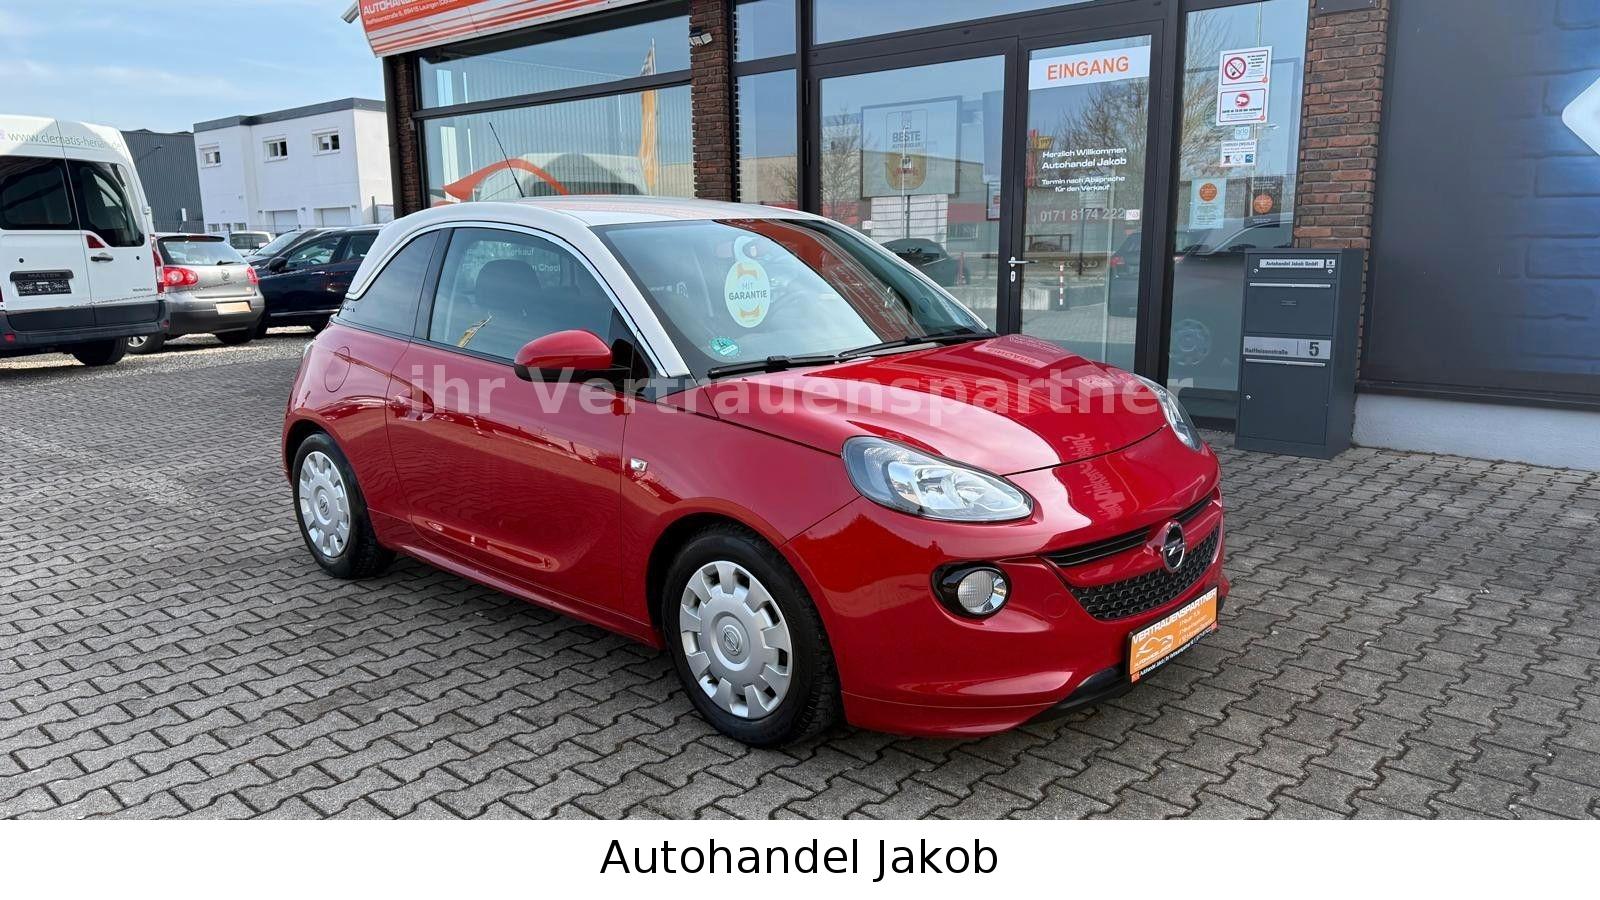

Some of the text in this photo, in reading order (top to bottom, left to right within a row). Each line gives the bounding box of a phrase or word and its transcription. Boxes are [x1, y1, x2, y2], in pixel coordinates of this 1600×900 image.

[1047, 56, 1129, 80] EINGANG
[892, 129, 921, 143] BESTE
[1042, 147, 1127, 158] Herzlich Willkommen
[1042, 157, 1127, 170] Autohandel Jakob
[1042, 178, 1066, 186] Termin
[1085, 175, 1126, 184] Absprache
[1055, 185, 1066, 193] für
[1080, 184, 1111, 193] Verkauf
[1040, 209, 1066, 222] 0171
[1070, 208, 1099, 221] 8174
[1102, 207, 1126, 220] 222
[728, 289, 768, 301] GARANTIE
[1308, 341, 1320, 357] 5
[1132, 589, 1217, 645] VERTRAUENSPARTNER
